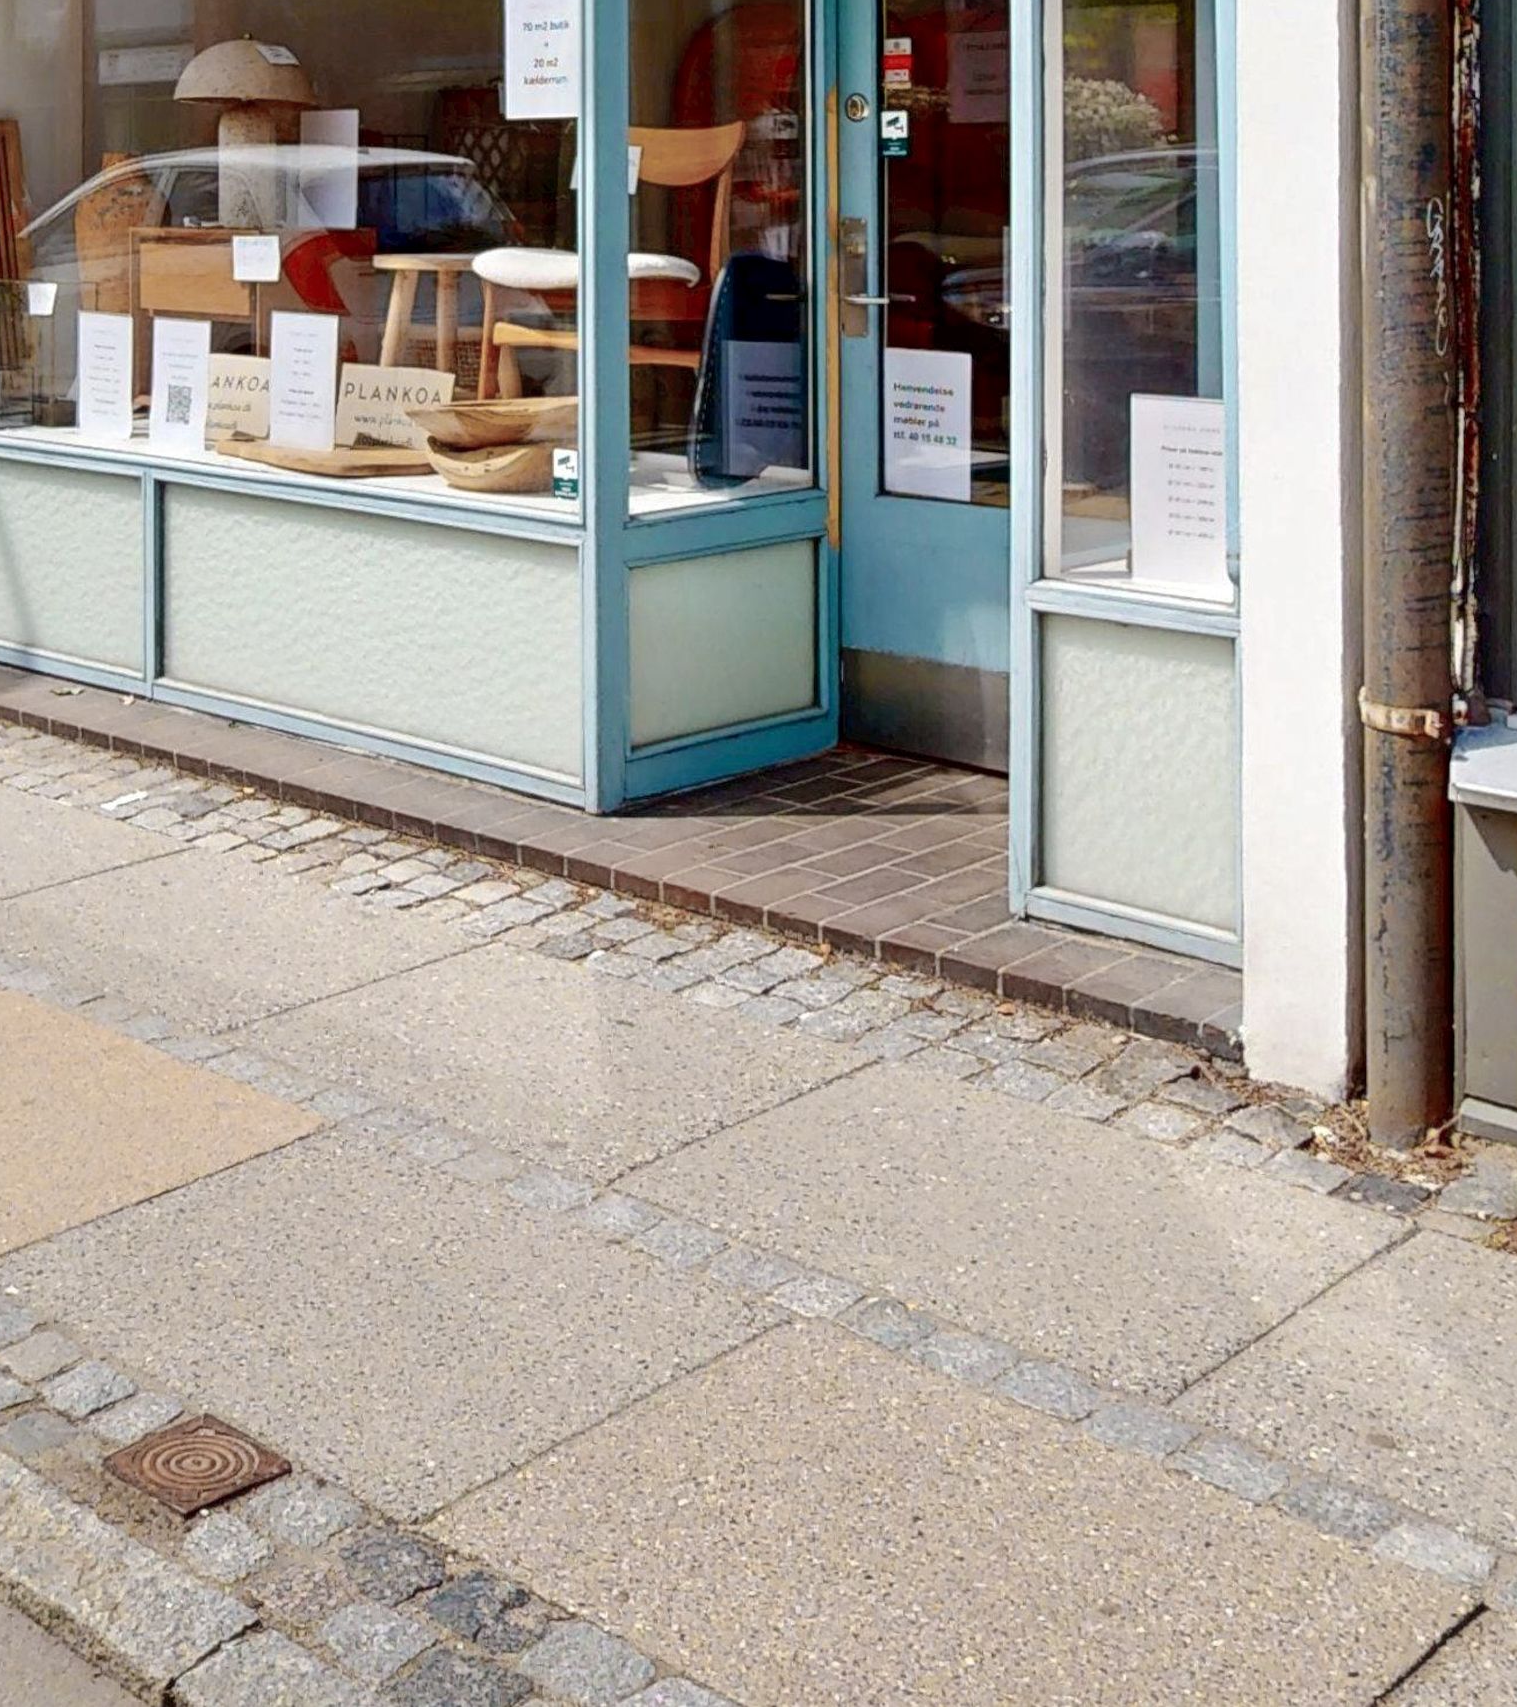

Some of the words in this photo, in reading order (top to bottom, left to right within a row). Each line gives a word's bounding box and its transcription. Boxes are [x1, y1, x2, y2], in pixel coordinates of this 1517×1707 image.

[212, 375, 271, 393] ANKOA
[893, 382, 954, 397] Henvendelse
[345, 382, 442, 405] PLANKOA
